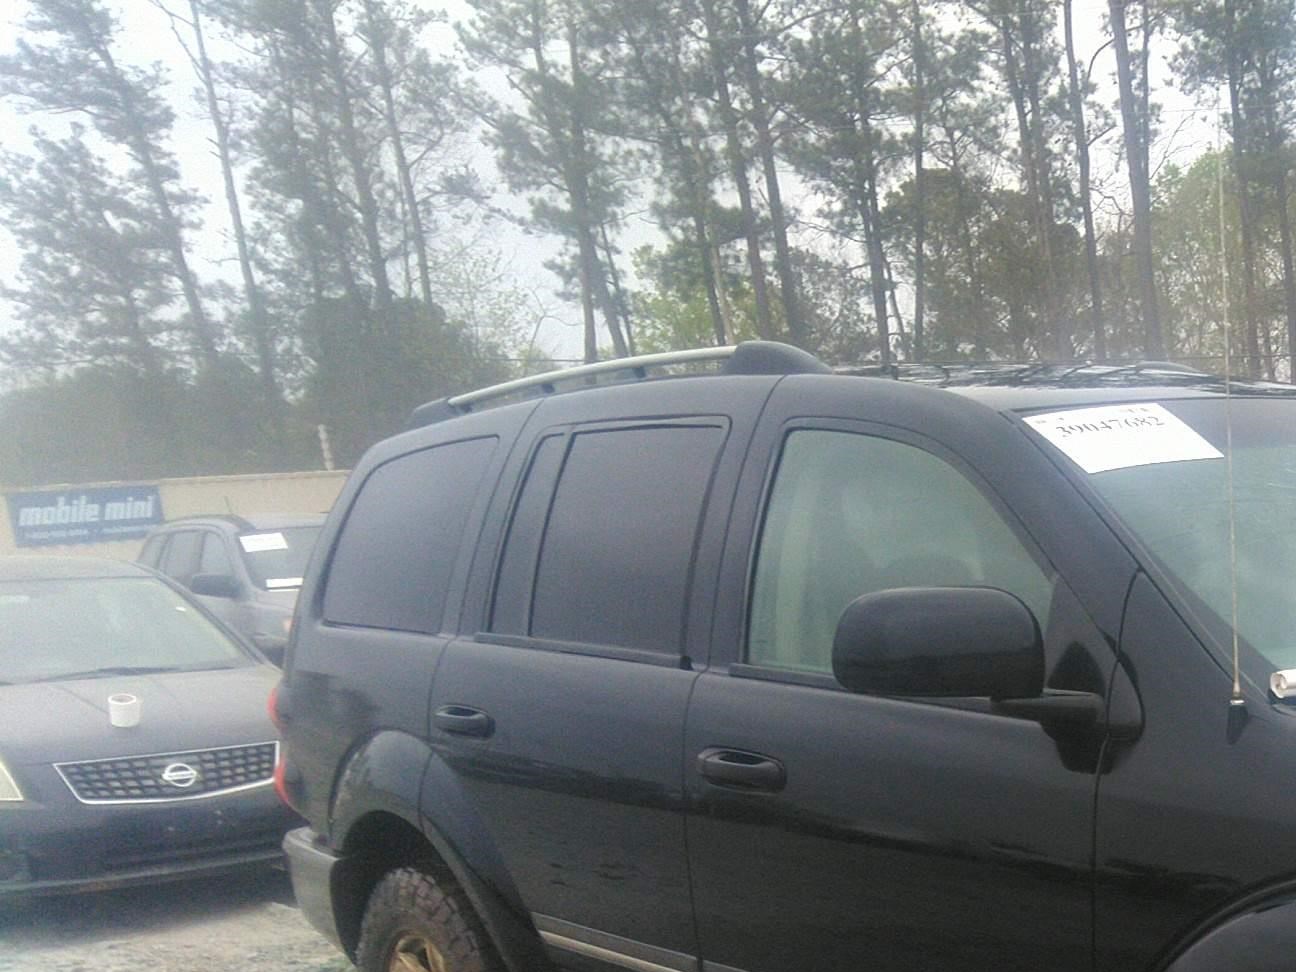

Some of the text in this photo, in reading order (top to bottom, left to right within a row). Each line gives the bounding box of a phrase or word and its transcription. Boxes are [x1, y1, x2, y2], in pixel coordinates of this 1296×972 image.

[1056, 415, 1166, 435] 39047682
[19, 494, 154, 526] mobile mini
